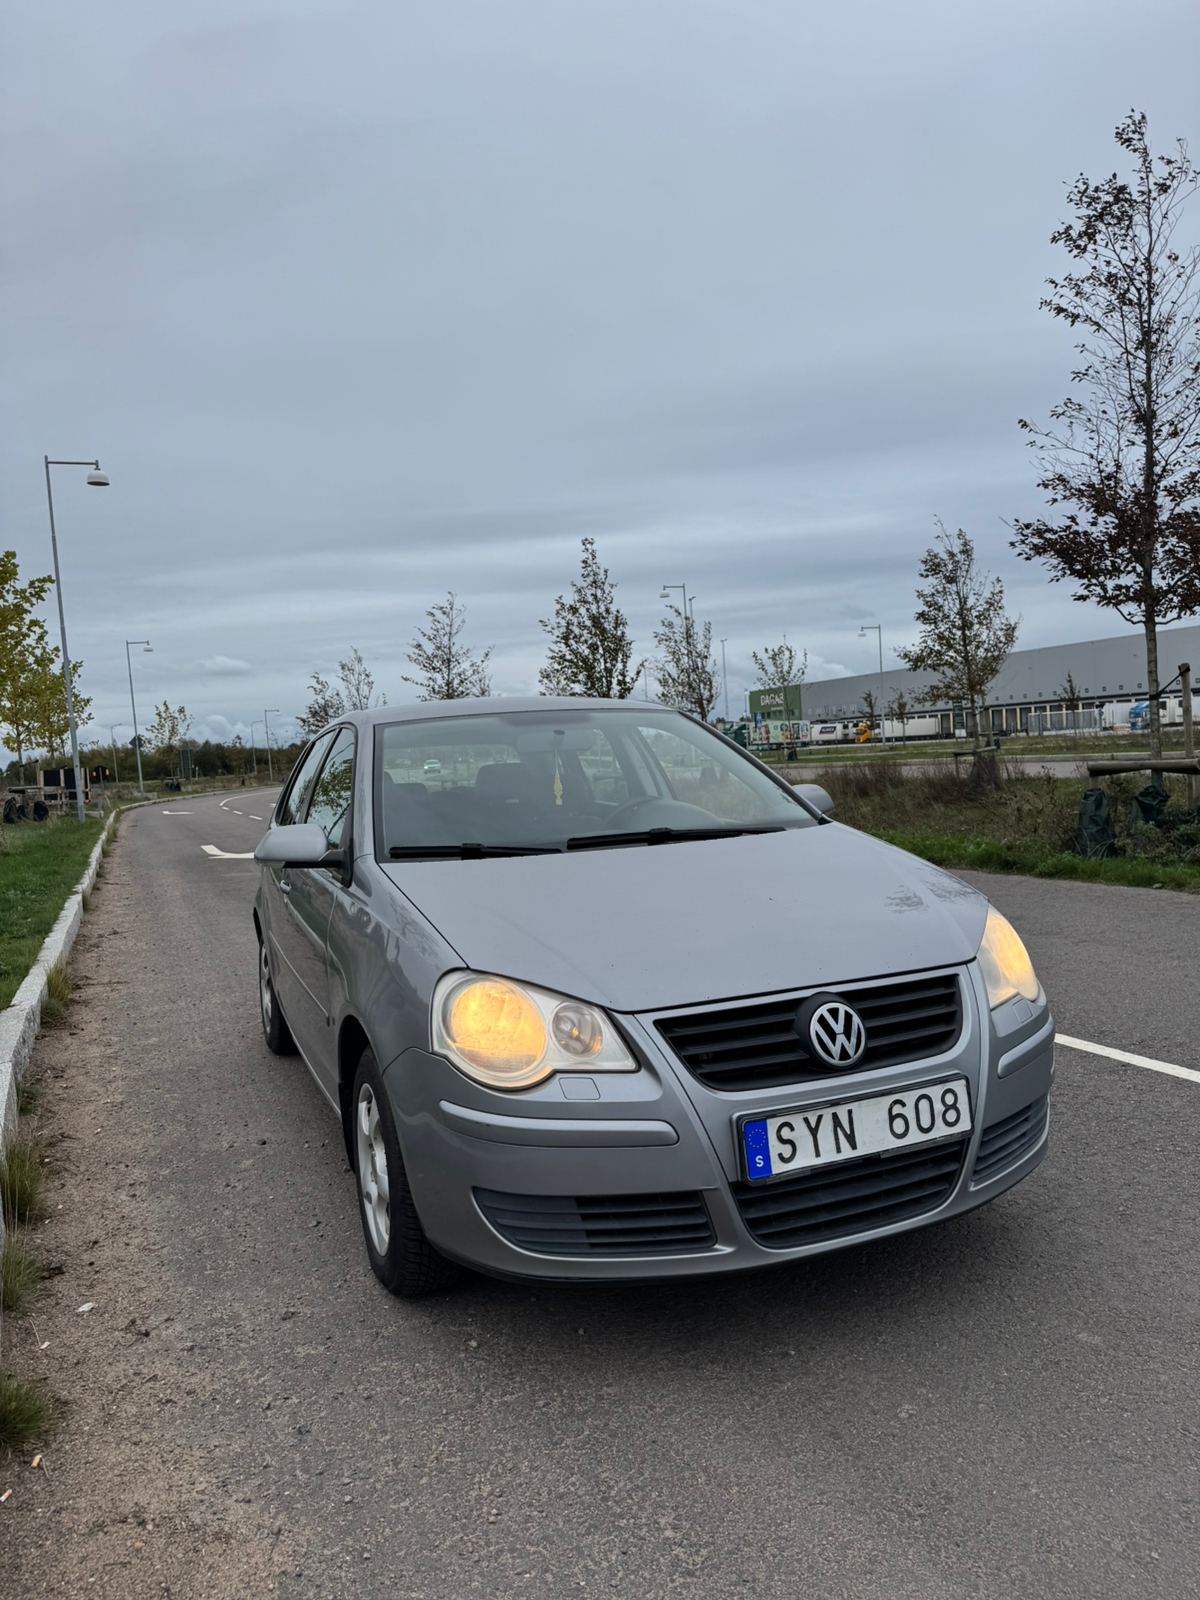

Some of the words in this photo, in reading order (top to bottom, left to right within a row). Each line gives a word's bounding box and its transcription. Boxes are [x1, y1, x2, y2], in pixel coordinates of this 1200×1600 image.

[810, 1002, 866, 1067] VW
[776, 1109, 858, 1164] SYN
[888, 1088, 961, 1140] 608
[755, 1155, 764, 1168] S
